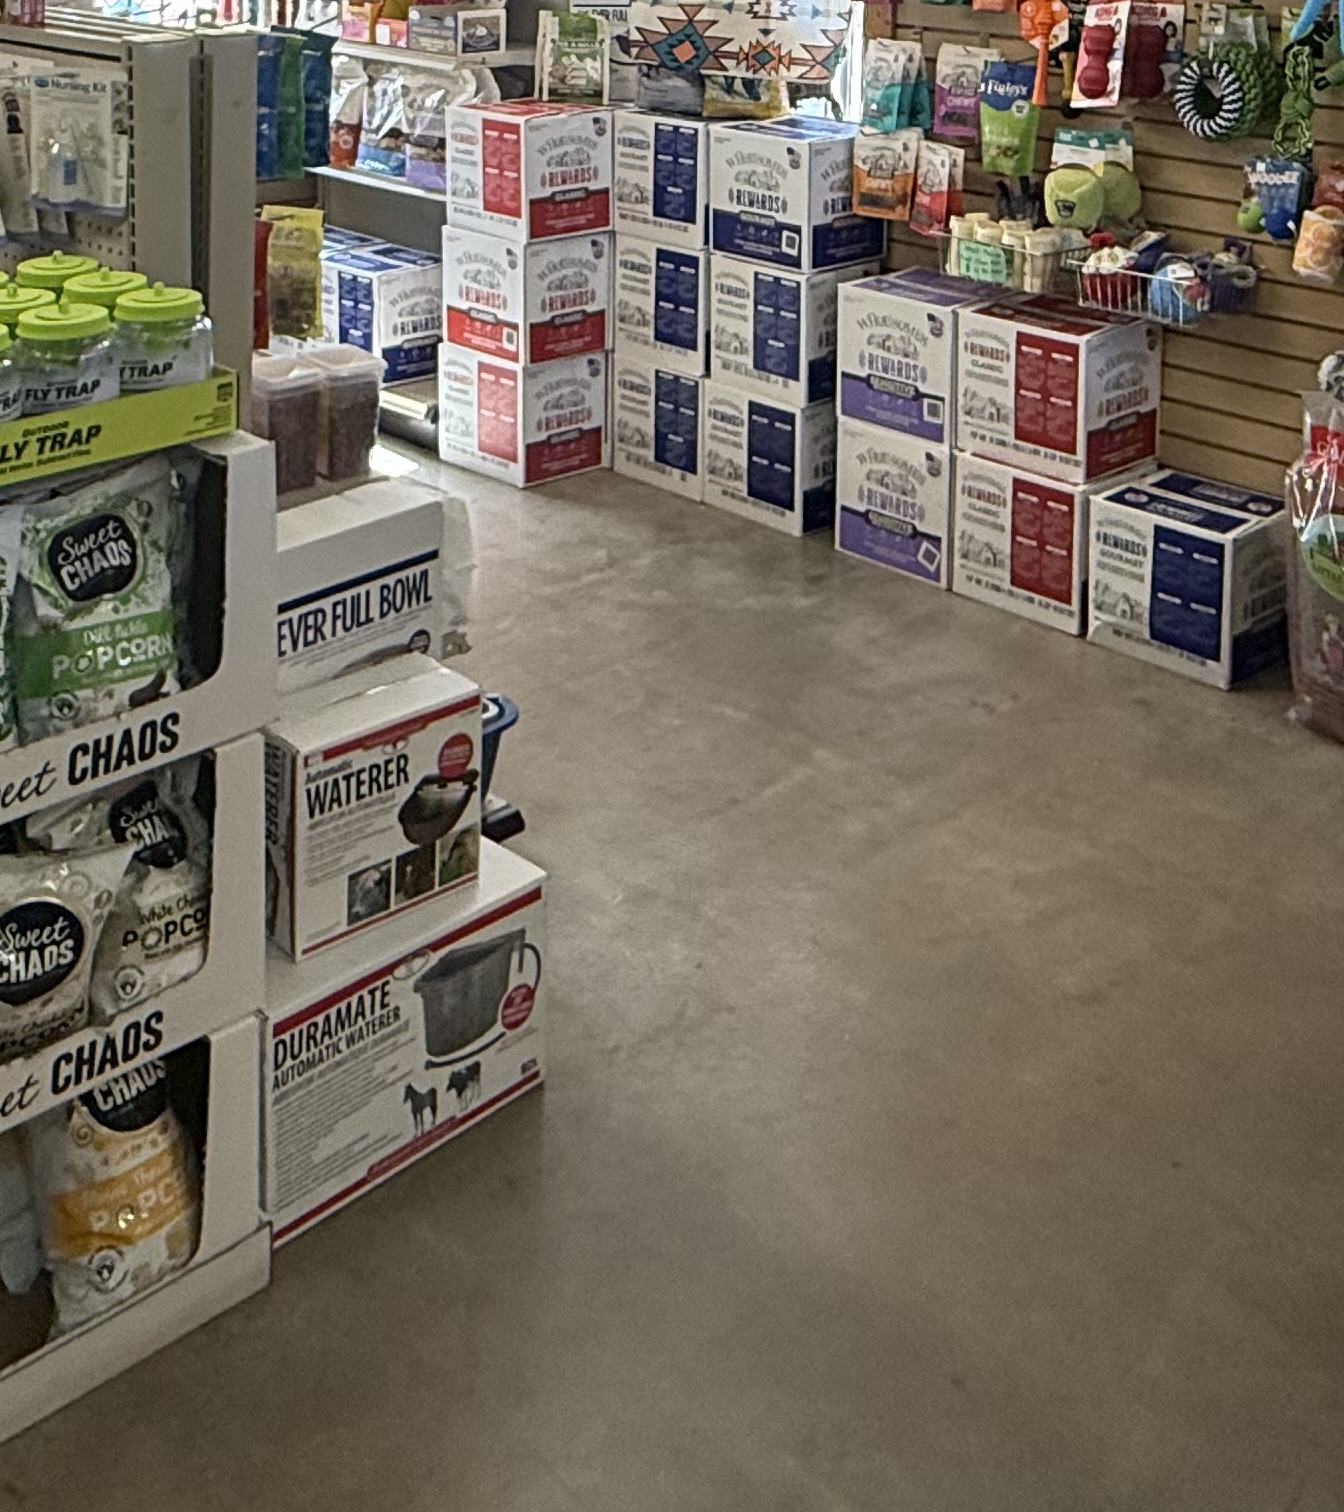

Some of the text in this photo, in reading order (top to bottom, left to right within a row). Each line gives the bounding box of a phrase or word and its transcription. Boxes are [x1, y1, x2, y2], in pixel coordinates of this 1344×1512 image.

[547, 167, 593, 188] REWARDS
[735, 188, 782, 215] REWARDS
[128, 361, 174, 378] TRAP
[867, 352, 920, 383] REWARDS
[24, 378, 102, 402] FLY TRAP
[35, 424, 103, 457] TRAP
[866, 487, 918, 521] REWARDS
[58, 520, 123, 565] Sweet
[59, 539, 133, 591] CHAOS
[277, 606, 328, 659] EVER
[330, 588, 375, 638] FULL
[378, 568, 433, 620] BOWL
[66, 711, 181, 788] CHAOS
[306, 752, 409, 820] WATERER
[3, 916, 71, 950] Sweet
[273, 980, 392, 1072] DURAMATE
[49, 1009, 164, 1096] CHAOS
[272, 1005, 401, 1093] AUTOMATIC WATERER
